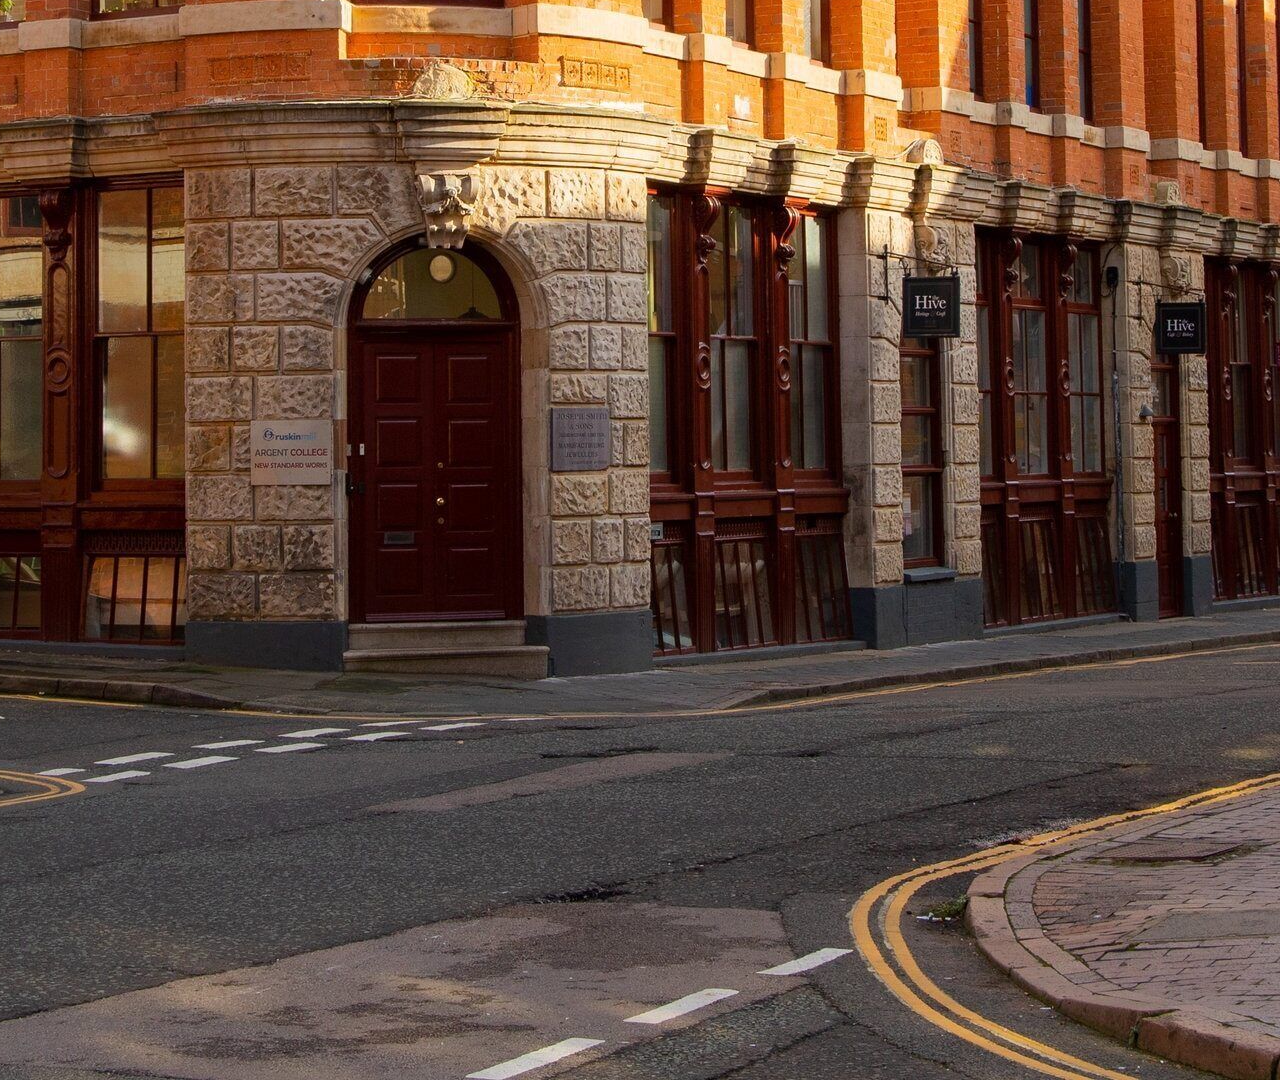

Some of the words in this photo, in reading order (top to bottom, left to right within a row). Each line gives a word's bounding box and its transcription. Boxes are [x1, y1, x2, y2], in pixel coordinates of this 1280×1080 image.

[914, 295, 947, 309] Hive
[1166, 319, 1195, 331] Hive
[557, 412, 585, 420] JOSEPH
[585, 412, 607, 420] SMITH
[255, 448, 288, 457] ARGENT
[290, 448, 328, 457] COLLEGE
